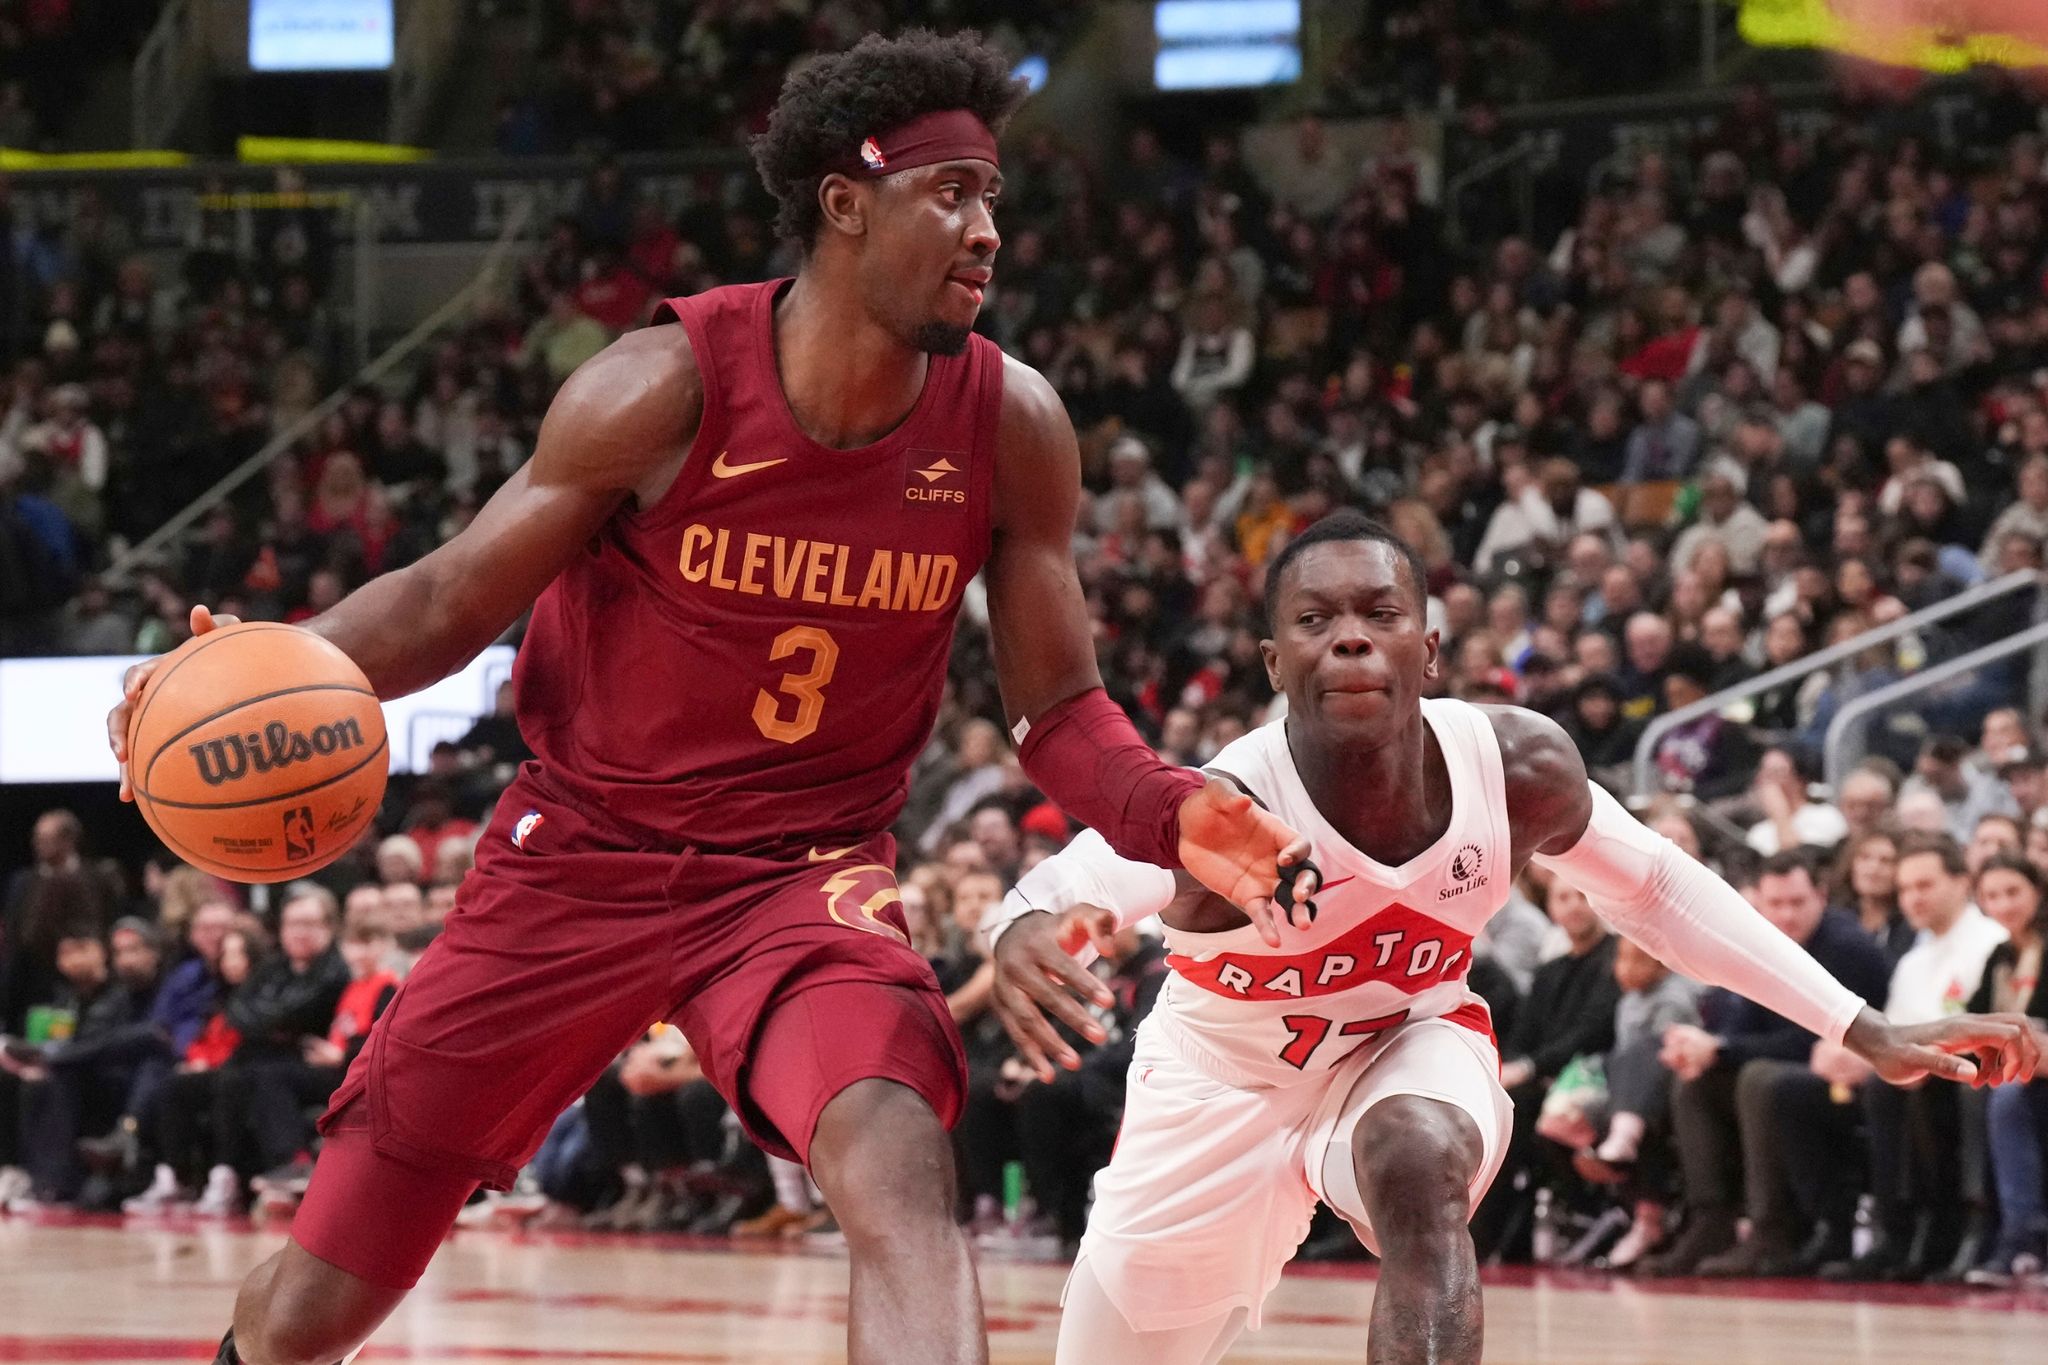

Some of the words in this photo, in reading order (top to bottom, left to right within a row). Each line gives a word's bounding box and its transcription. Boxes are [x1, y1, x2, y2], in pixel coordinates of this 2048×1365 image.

[905, 487, 965, 503] CLIFFS
[679, 523, 958, 611] CLEVELAND
[751, 625, 840, 744] 3
[188, 716, 365, 786] Wilson
[1438, 886, 1463, 901] Sun
[1466, 875, 1488, 893] Life
[1278, 1008, 1411, 1071] 17
